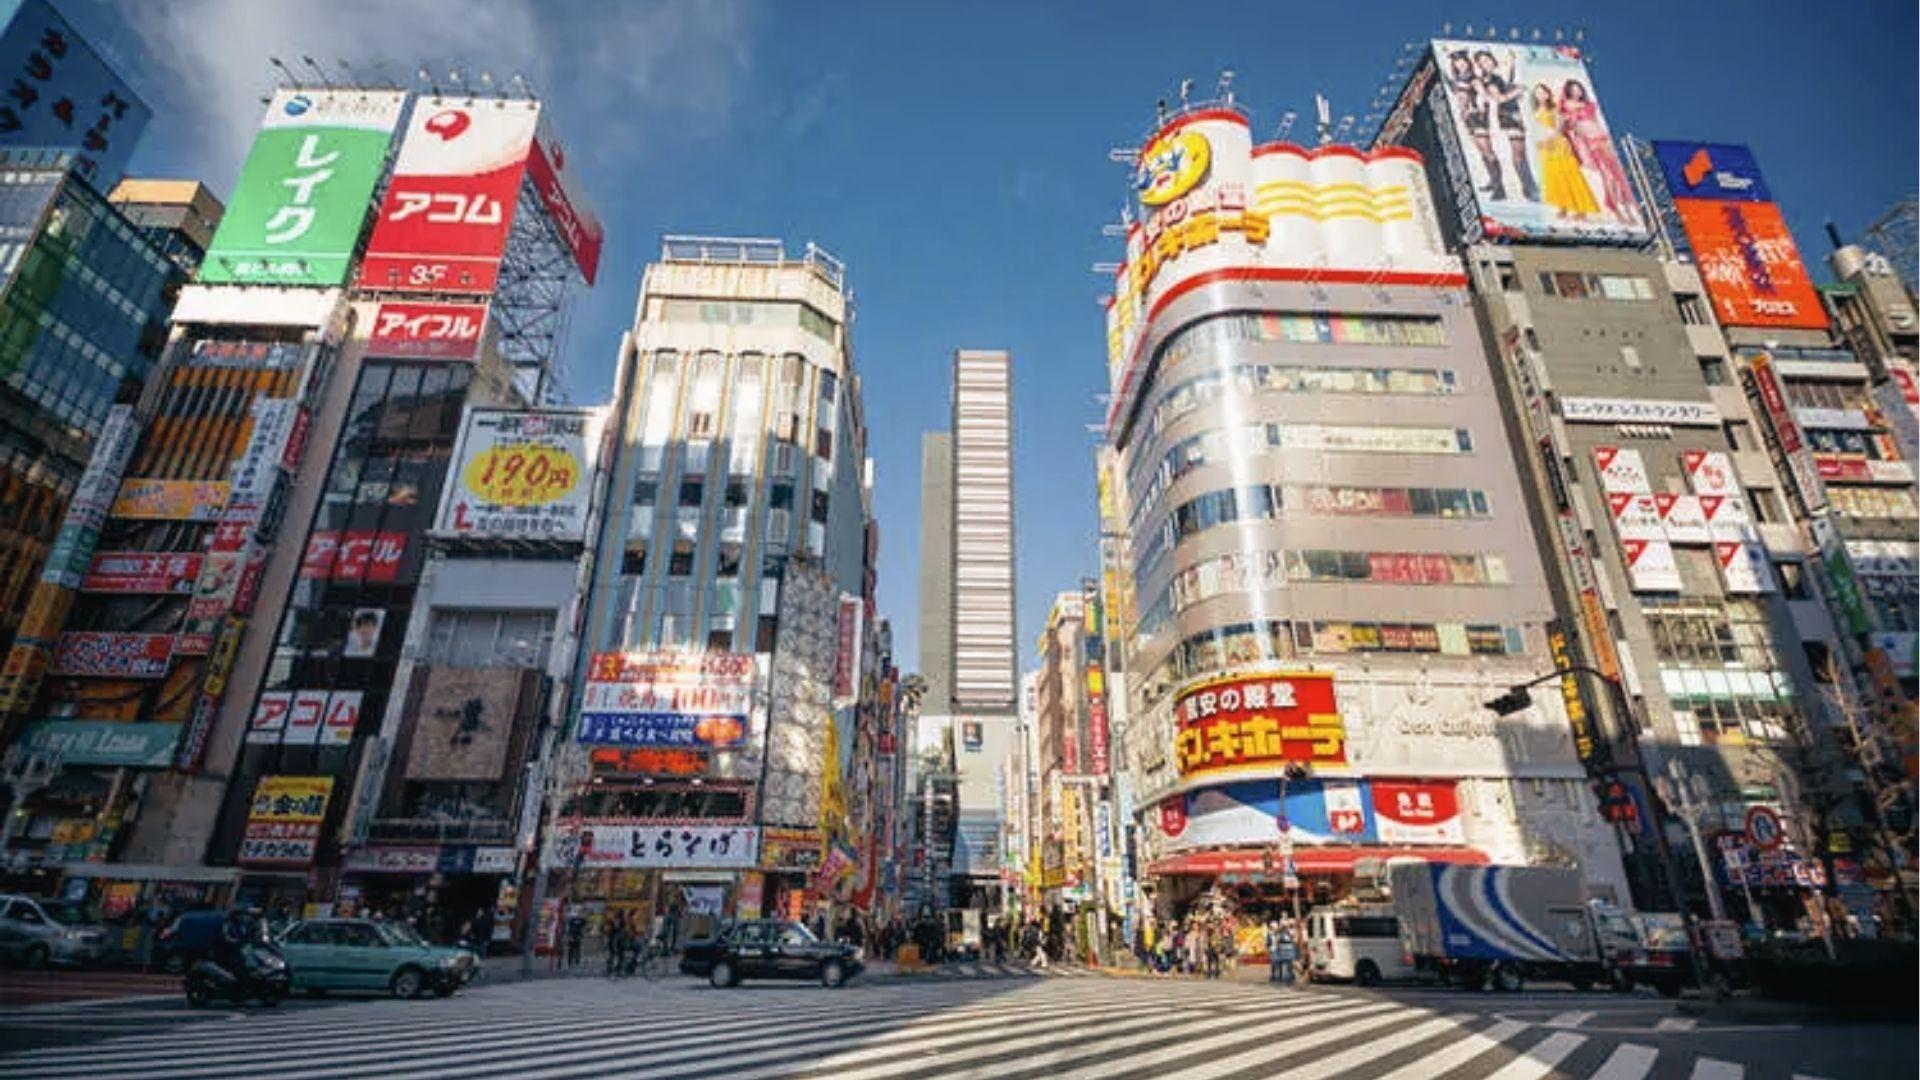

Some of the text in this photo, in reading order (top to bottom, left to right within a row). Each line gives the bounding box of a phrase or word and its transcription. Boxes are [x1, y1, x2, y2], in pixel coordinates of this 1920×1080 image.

[265, 134, 340, 244] レイク
[389, 191, 501, 224] アコム
[377, 311, 478, 340] アイフル
[480, 453, 570, 490] 190円
[254, 697, 357, 727] アコム
